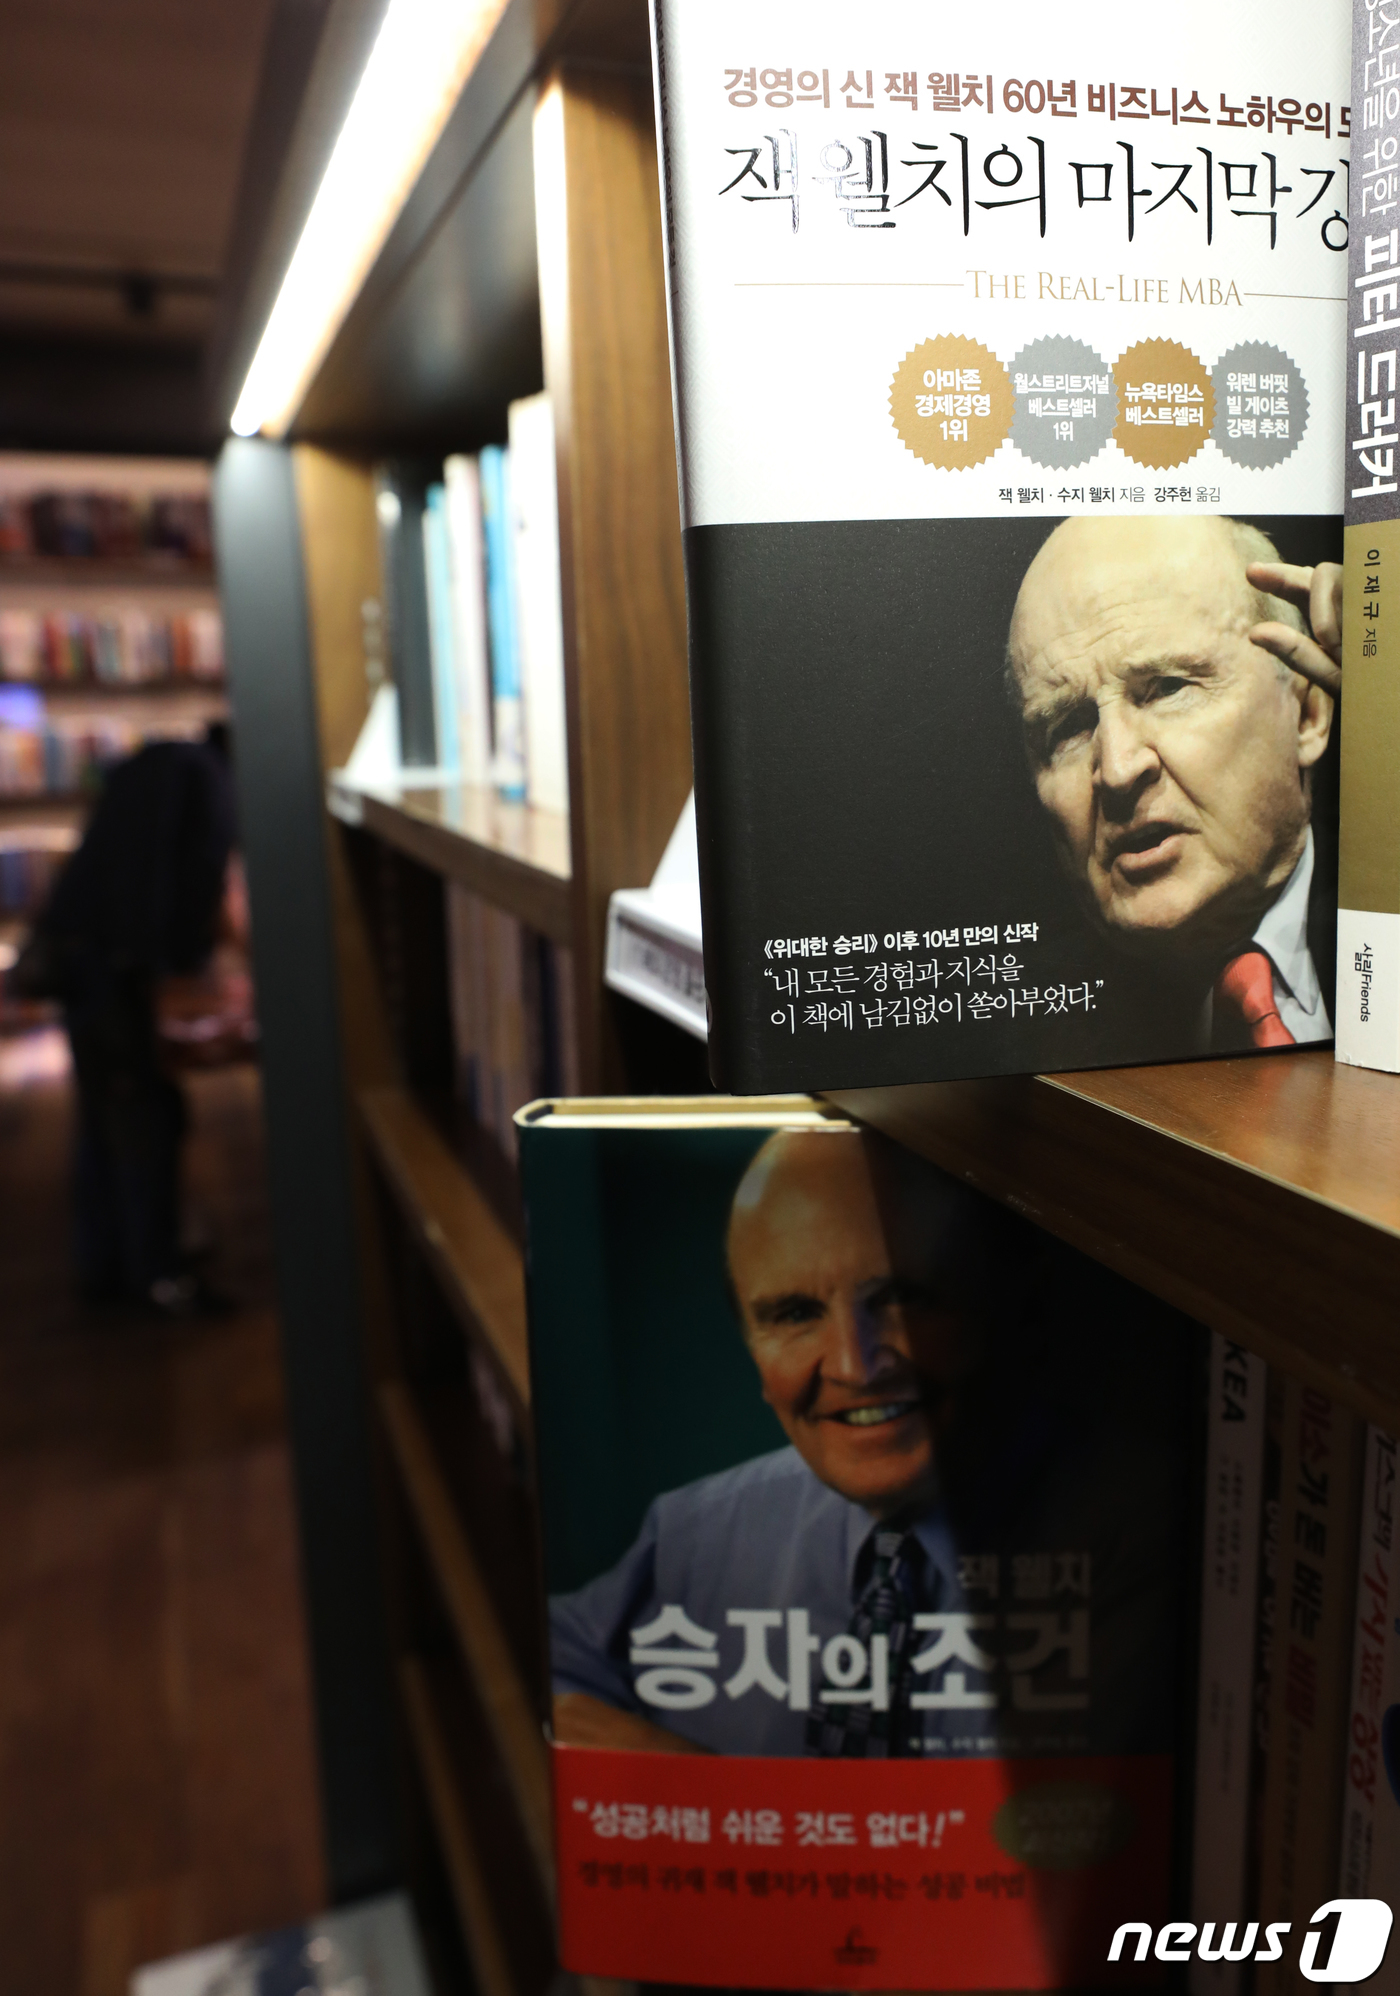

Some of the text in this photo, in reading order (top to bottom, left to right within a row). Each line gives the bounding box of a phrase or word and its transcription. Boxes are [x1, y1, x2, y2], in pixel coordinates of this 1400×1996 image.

[722, 67, 831, 109] 경영의
[839, 70, 875, 109] 신
[884, 72, 918, 111] 잭
[926, 72, 994, 114] 웰치
[1002, 78, 1078, 118] 60년
[1087, 82, 1211, 125] 비즈니스
[1217, 93, 1331, 139] 노하우의
[718, 128, 799, 235] 잭
[812, 130, 1046, 238] 웰치의
[1068, 141, 1292, 250] 마지막
[1362, 136, 1398, 217] 위한
[1179, 276, 1243, 307] MBA
[1354, 228, 1400, 338] 피터
[922, 368, 982, 392] 아마존
[1014, 372, 1109, 395] 월스트리트저널
[1124, 382, 1205, 403] 뉴욕타임스
[1226, 372, 1289, 394] 워렌 버핏
[914, 393, 991, 418] 경제경영
[1028, 397, 1097, 418] 베스트셀러
[1125, 405, 1204, 427] 베스트셀러
[1226, 396, 1290, 416] 빌 게이츠
[939, 418, 968, 442] 1위
[1053, 420, 1074, 442] 1위
[1226, 418, 1290, 439] 강력 추천
[1351, 349, 1399, 499] 드러커
[998, 486, 1221, 504] 잭 웰치 수지 웰치 지음 강주헌 옮김
[1362, 628, 1378, 658] 지음
[883, 930, 920, 953] 이후
[922, 927, 960, 950] 10년
[963, 924, 999, 947] 만의
[1002, 922, 1039, 943] 신작
[804, 963, 861, 996] 모든
[863, 958, 944, 993] 경험과
[945, 953, 1025, 985] 지식을
[770, 1003, 796, 1035] 이
[802, 1000, 854, 1033] 책에
[859, 992, 963, 1030] 남김없이
[629, 1604, 1092, 1713] 승자의 조건
[721, 1808, 785, 1846] 쉬운
[794, 1809, 857, 1848] 것도
